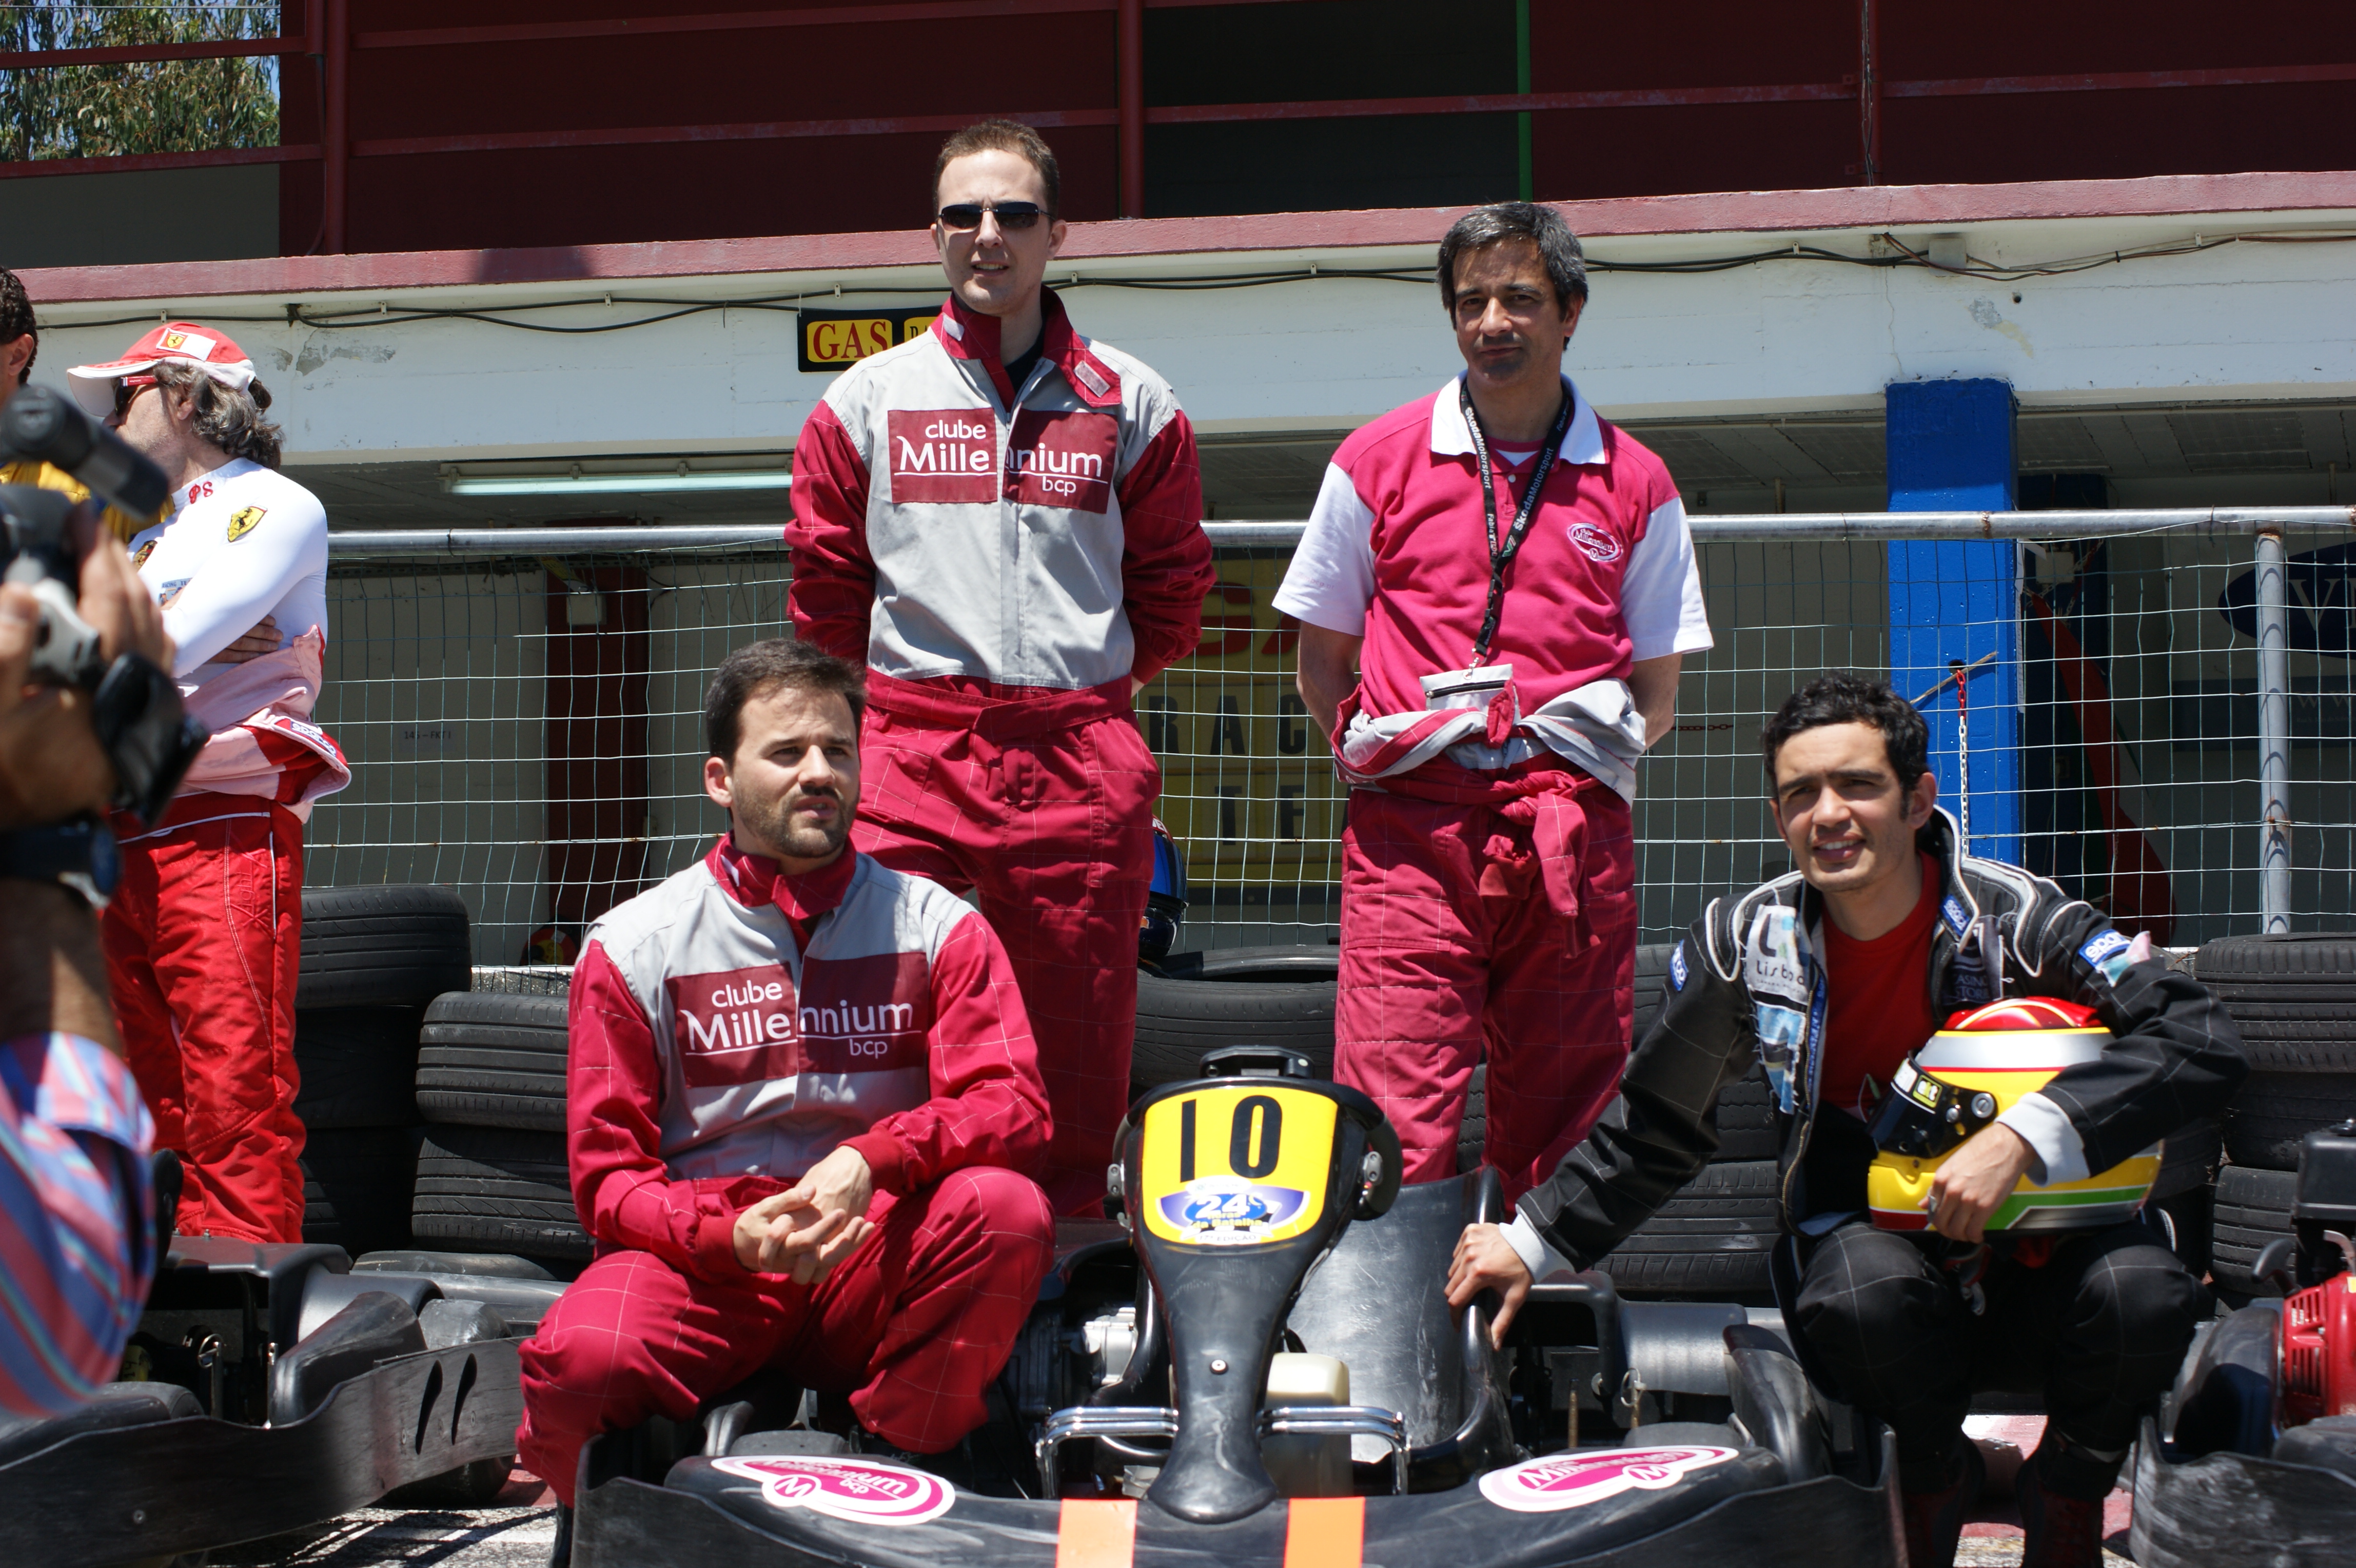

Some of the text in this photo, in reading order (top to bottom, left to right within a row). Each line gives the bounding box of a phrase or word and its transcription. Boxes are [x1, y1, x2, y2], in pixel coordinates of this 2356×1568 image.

[813, 321, 888, 360] GAS
[925, 419, 987, 439] clube
[1042, 476, 1076, 496] bcp
[1575, 529, 1613, 551] Millennium
[712, 979, 783, 1008] clube
[849, 1037, 888, 1060] bcp
[1180, 1095, 1283, 1183] 10
[1195, 1194, 1250, 1219] 24
